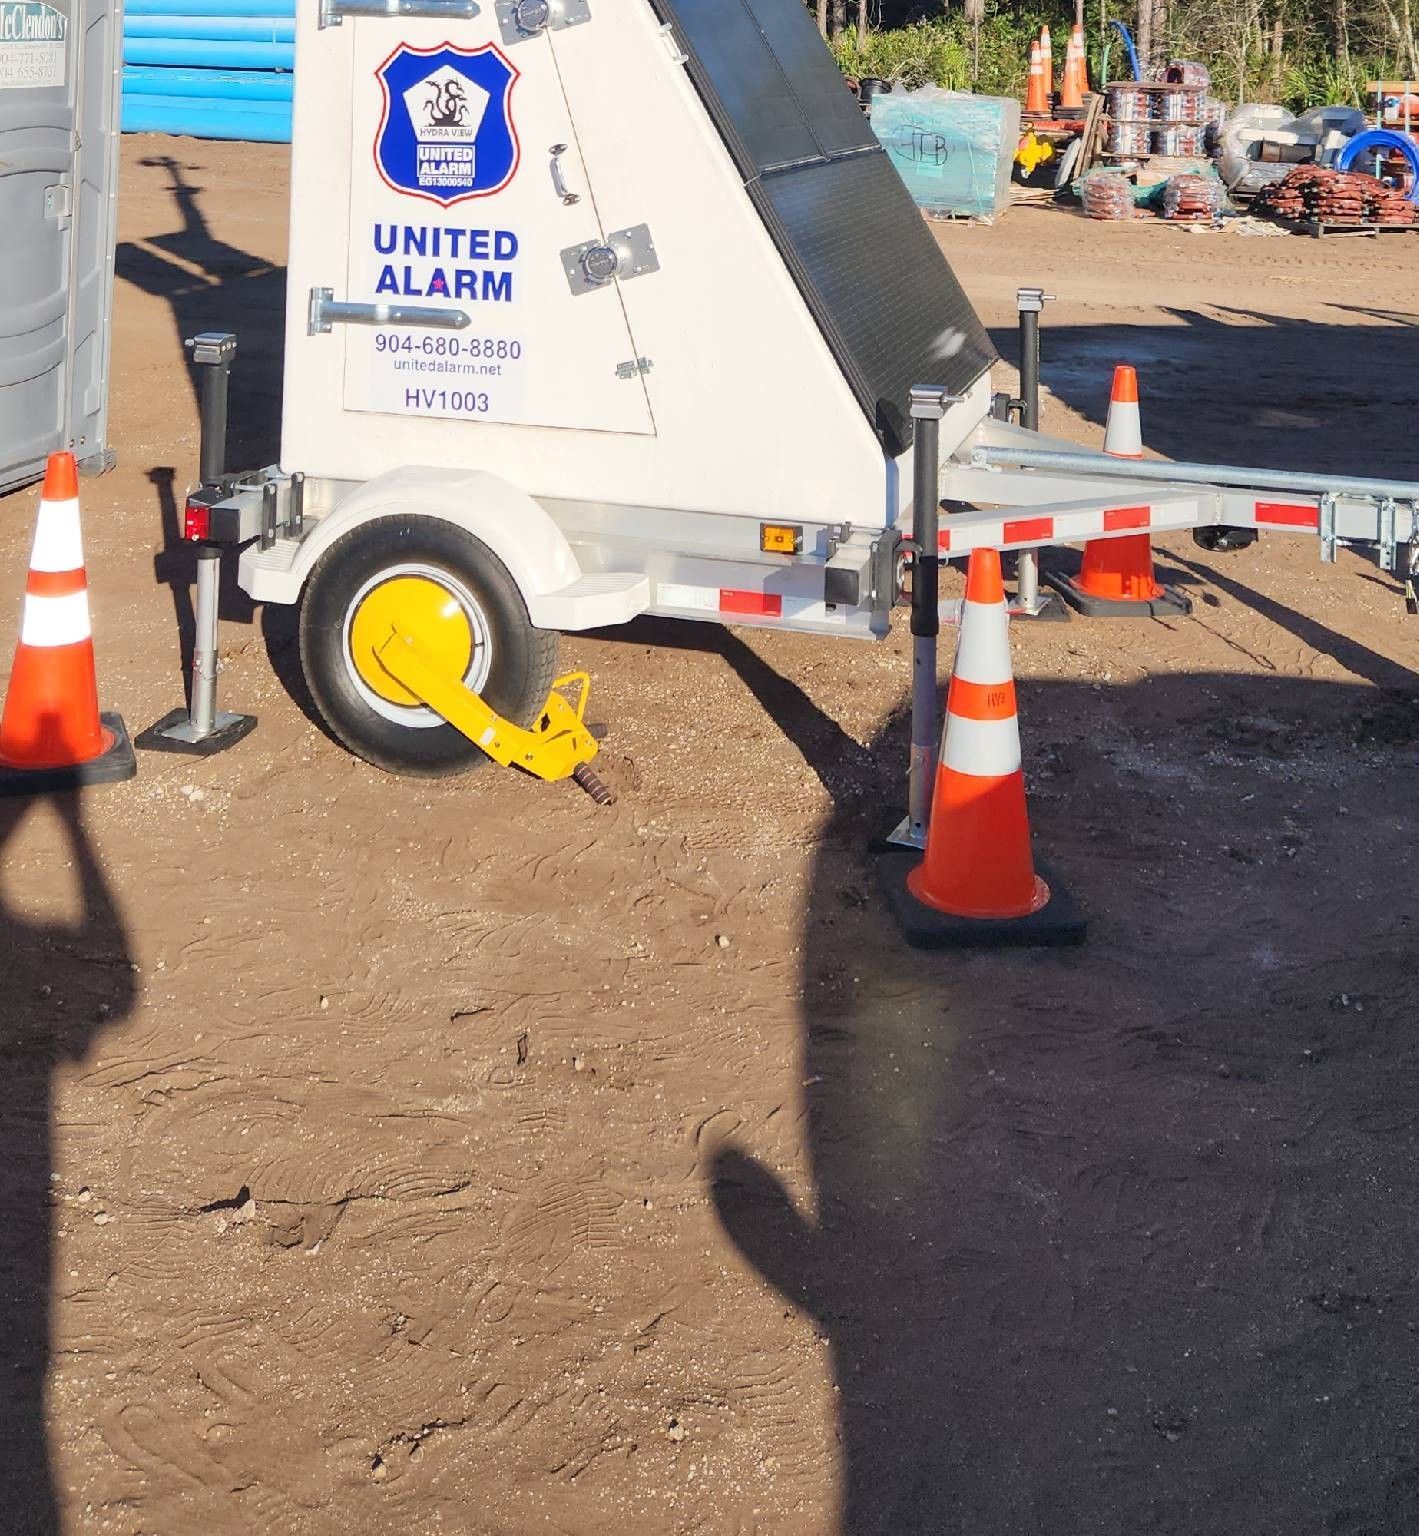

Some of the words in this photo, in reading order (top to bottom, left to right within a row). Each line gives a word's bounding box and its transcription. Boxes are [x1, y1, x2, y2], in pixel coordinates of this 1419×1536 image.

[419, 128, 450, 137] HYDRA
[451, 128, 473, 137] VIEW
[419, 147, 473, 161] UNITED
[420, 161, 472, 175] ALARM
[418, 176, 473, 187] EG13000540
[374, 223, 519, 261] UNITED
[375, 264, 513, 303] ALARM
[375, 333, 522, 360] 904-680-8880
[394, 358, 502, 377] unitedalarm.net
[405, 388, 490, 413] HV1003
